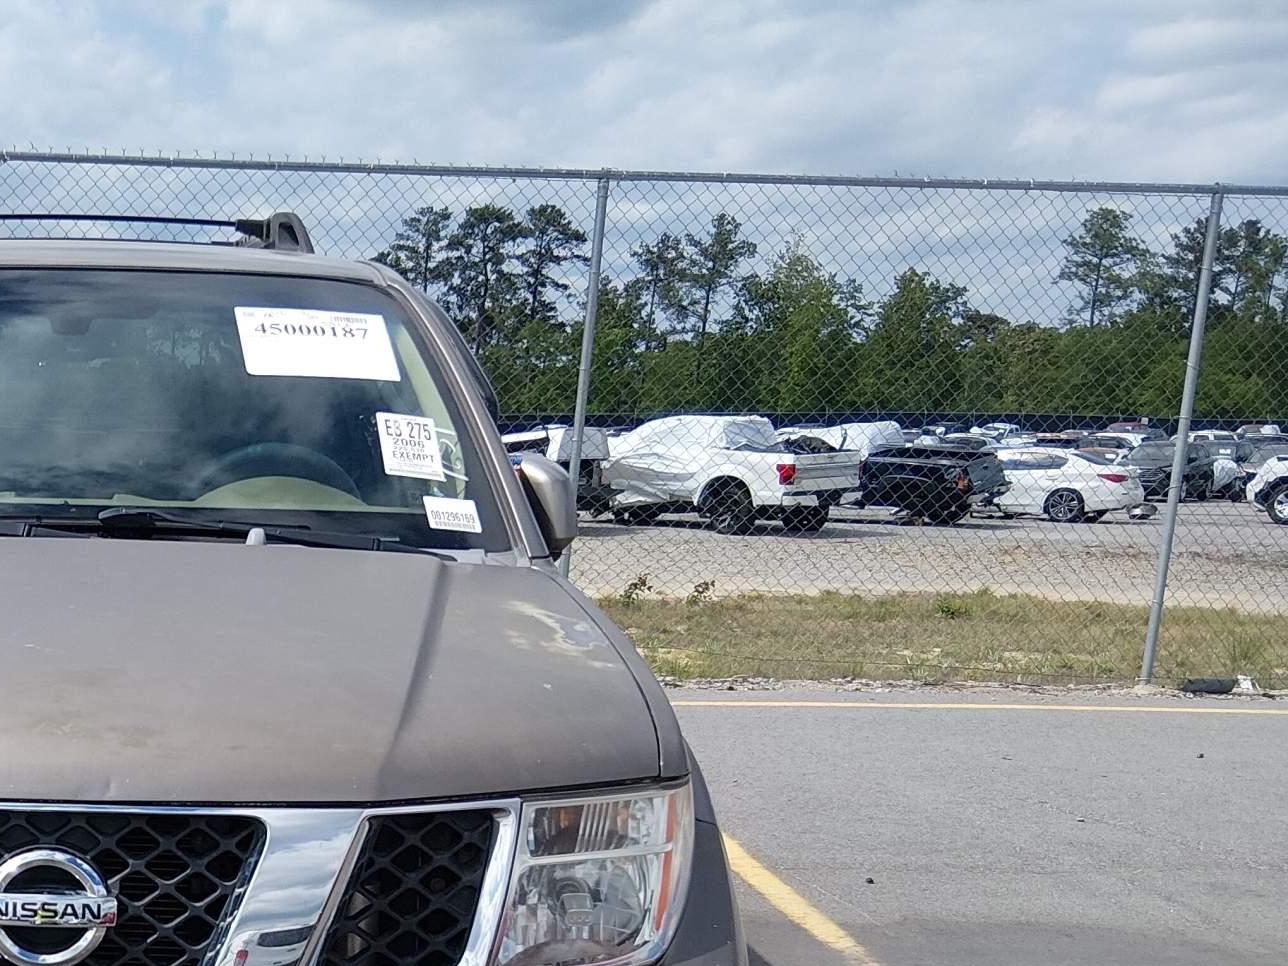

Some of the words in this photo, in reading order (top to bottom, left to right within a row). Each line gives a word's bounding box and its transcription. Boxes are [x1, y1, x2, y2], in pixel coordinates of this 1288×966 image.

[254, 323, 369, 339] 45000187
[406, 421, 432, 441] 275
[392, 450, 435, 463] EXEMPT
